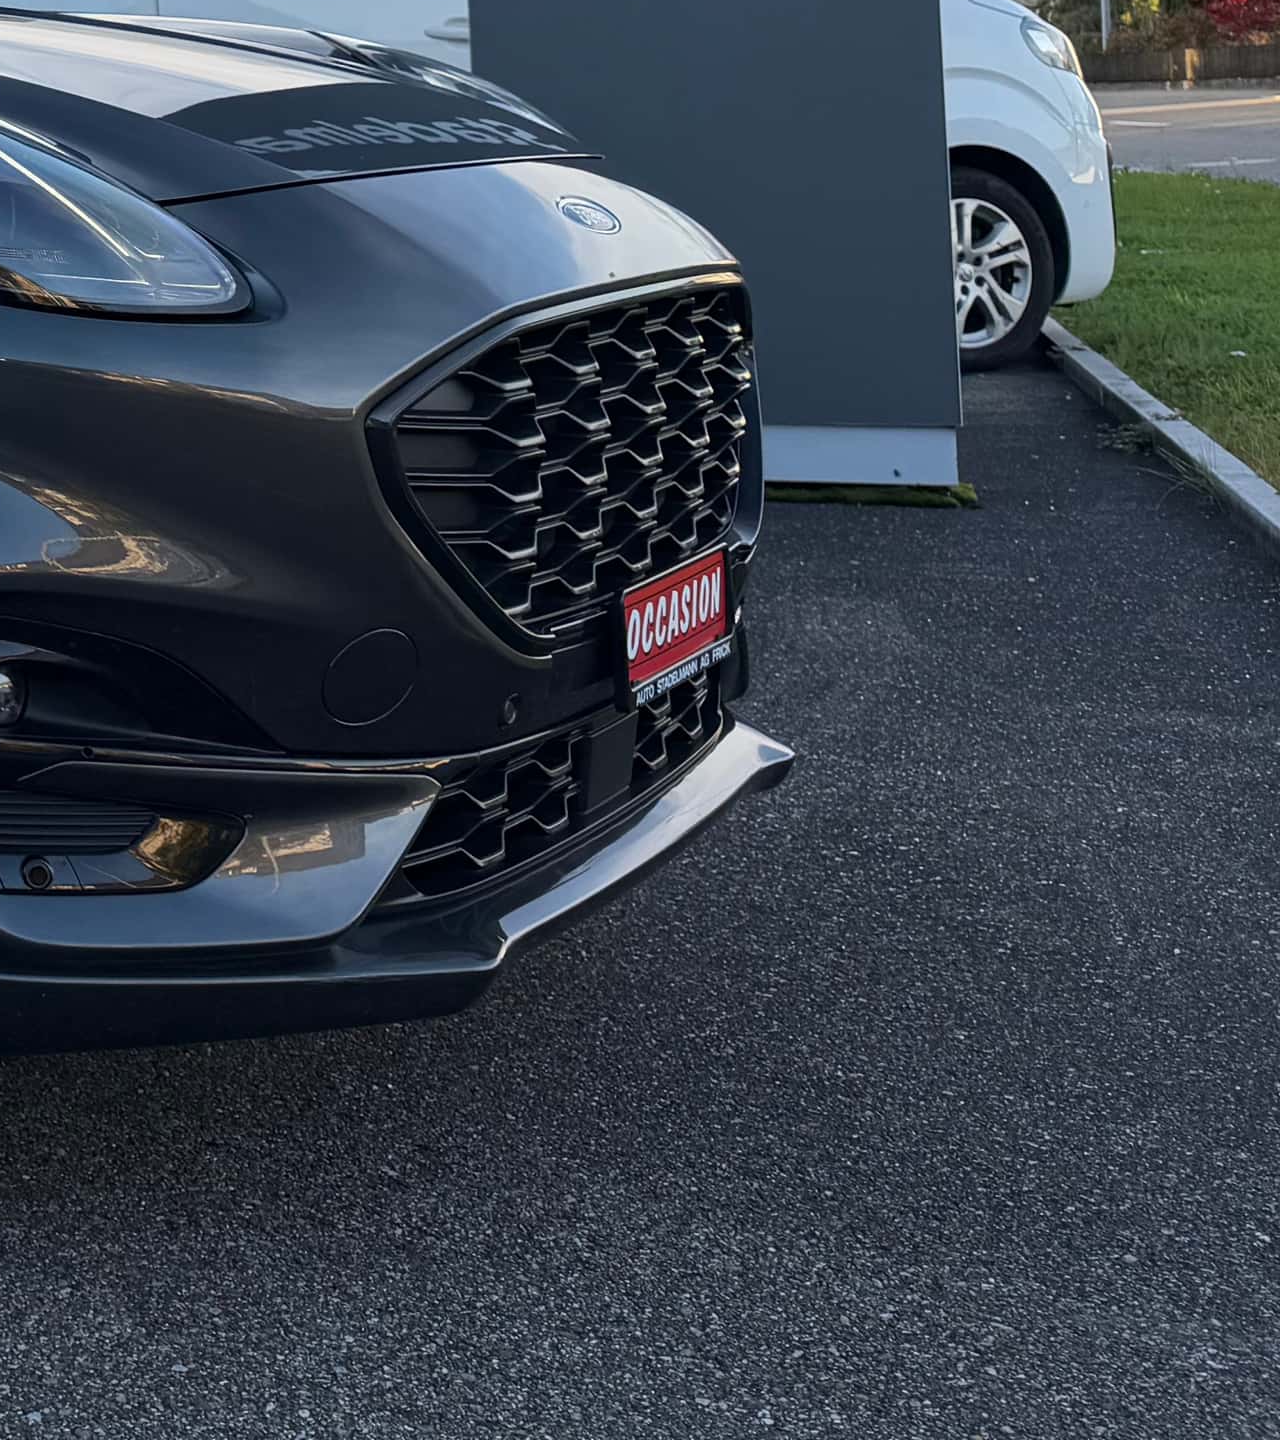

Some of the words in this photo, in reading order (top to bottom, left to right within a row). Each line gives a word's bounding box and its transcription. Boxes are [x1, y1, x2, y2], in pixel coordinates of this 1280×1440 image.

[626, 566, 721, 661] OCCASION
[636, 685, 655, 707] AUTO
[656, 661, 699, 694] STADELMANN
[700, 654, 710, 672] AG
[712, 642, 732, 663] FRICK
